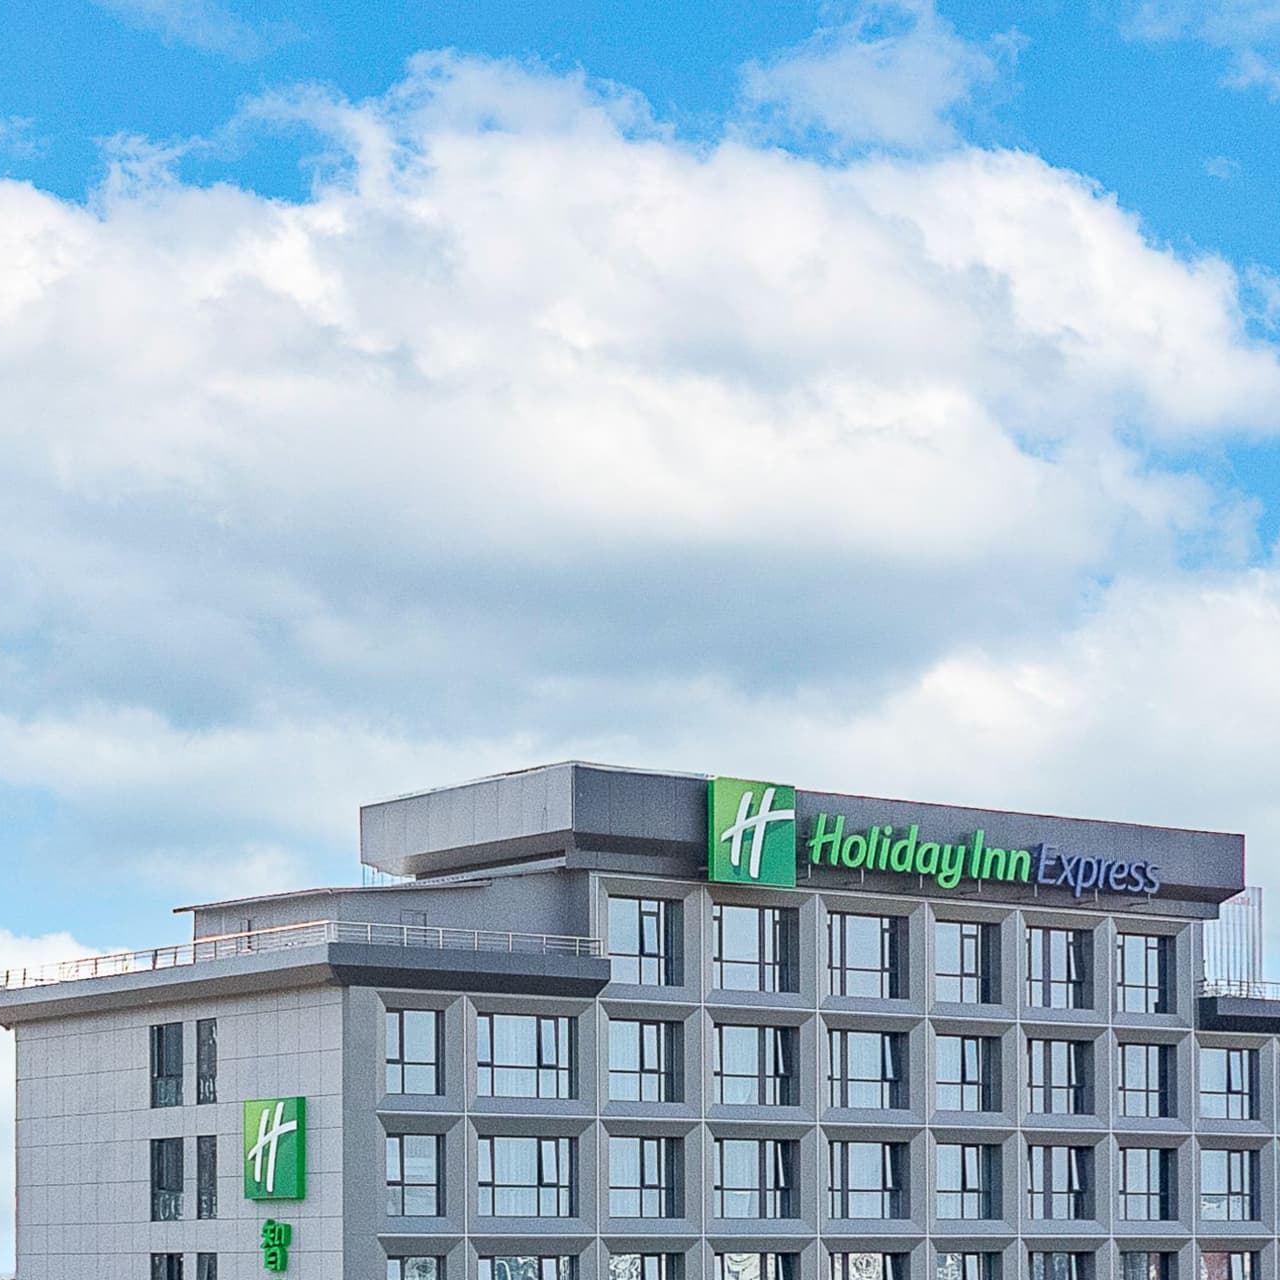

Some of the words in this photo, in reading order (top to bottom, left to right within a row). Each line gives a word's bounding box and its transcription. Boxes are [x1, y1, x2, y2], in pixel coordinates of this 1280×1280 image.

[809, 813, 965, 889] Holiday
[971, 829, 1031, 882] Inn
[1036, 842, 1161, 898] Express
